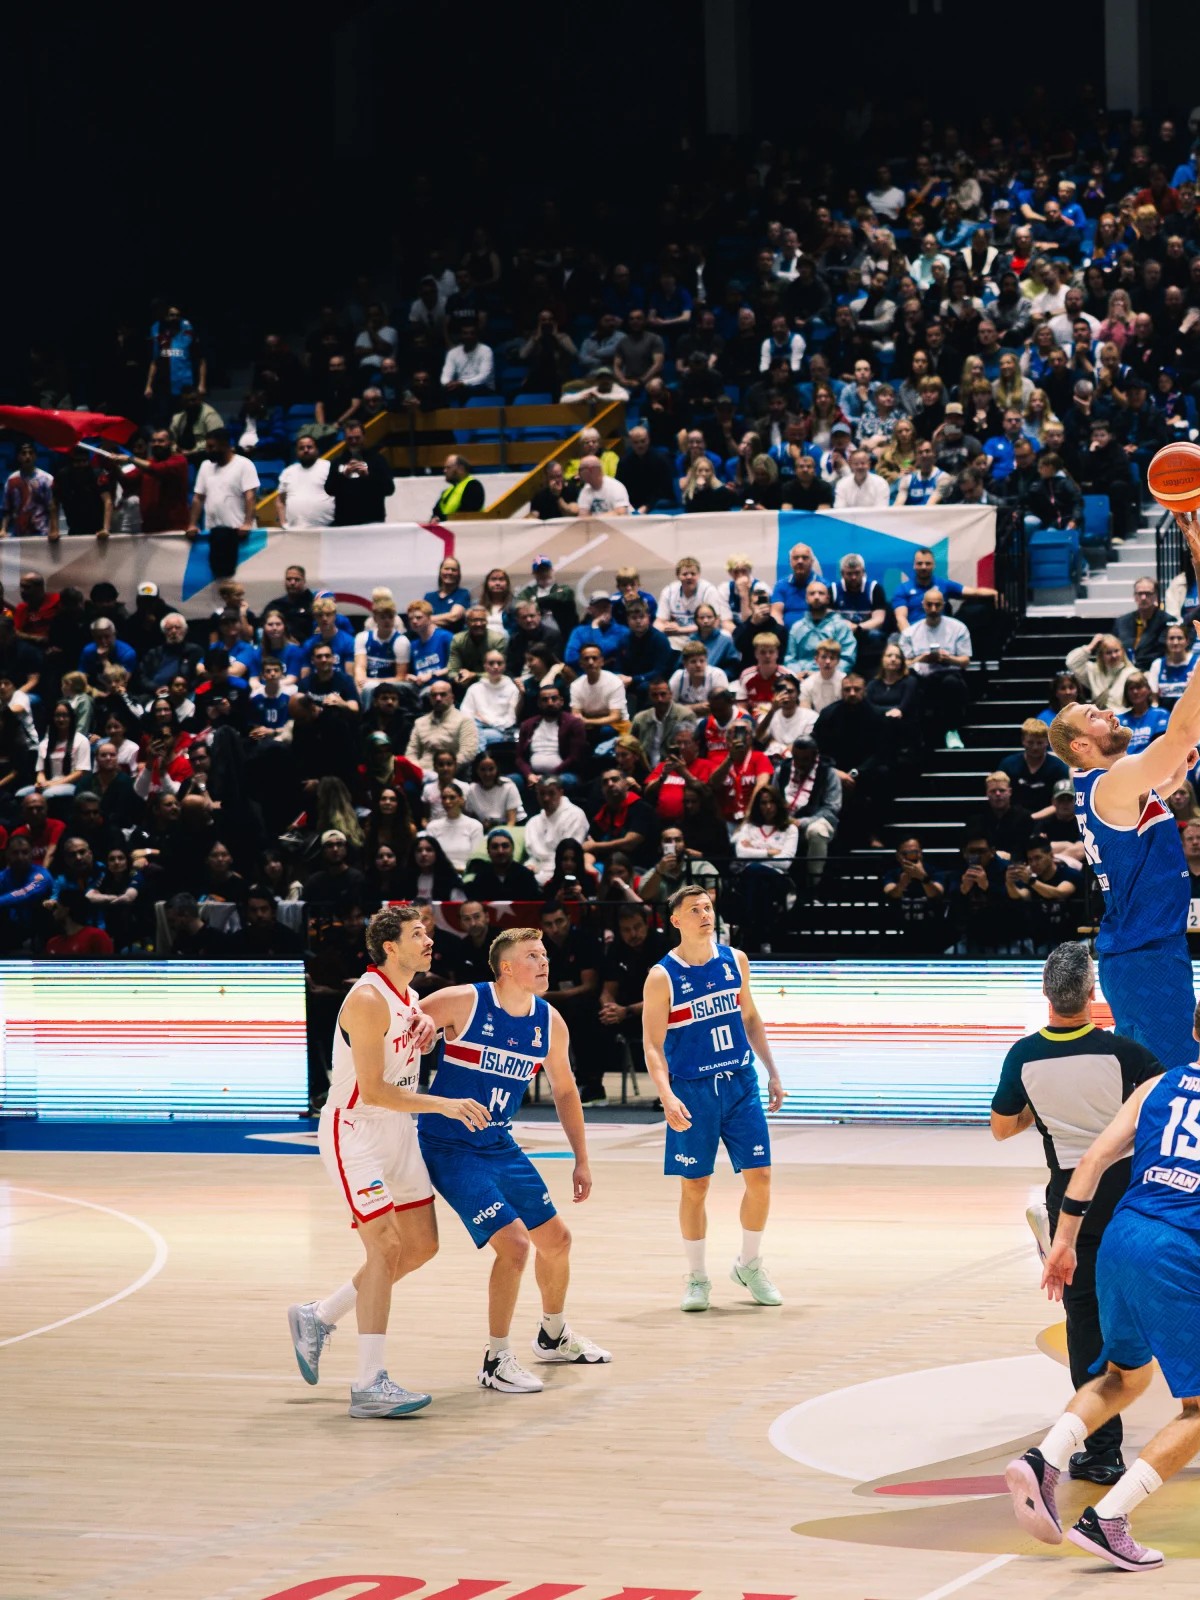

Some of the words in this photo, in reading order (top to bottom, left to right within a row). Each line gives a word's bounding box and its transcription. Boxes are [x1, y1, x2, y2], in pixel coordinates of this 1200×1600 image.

[691, 993, 738, 1019] ÍSLAND
[710, 1024, 735, 1052] 10
[698, 1058, 740, 1072] ICELANDAIR
[489, 1087, 511, 1113] 14
